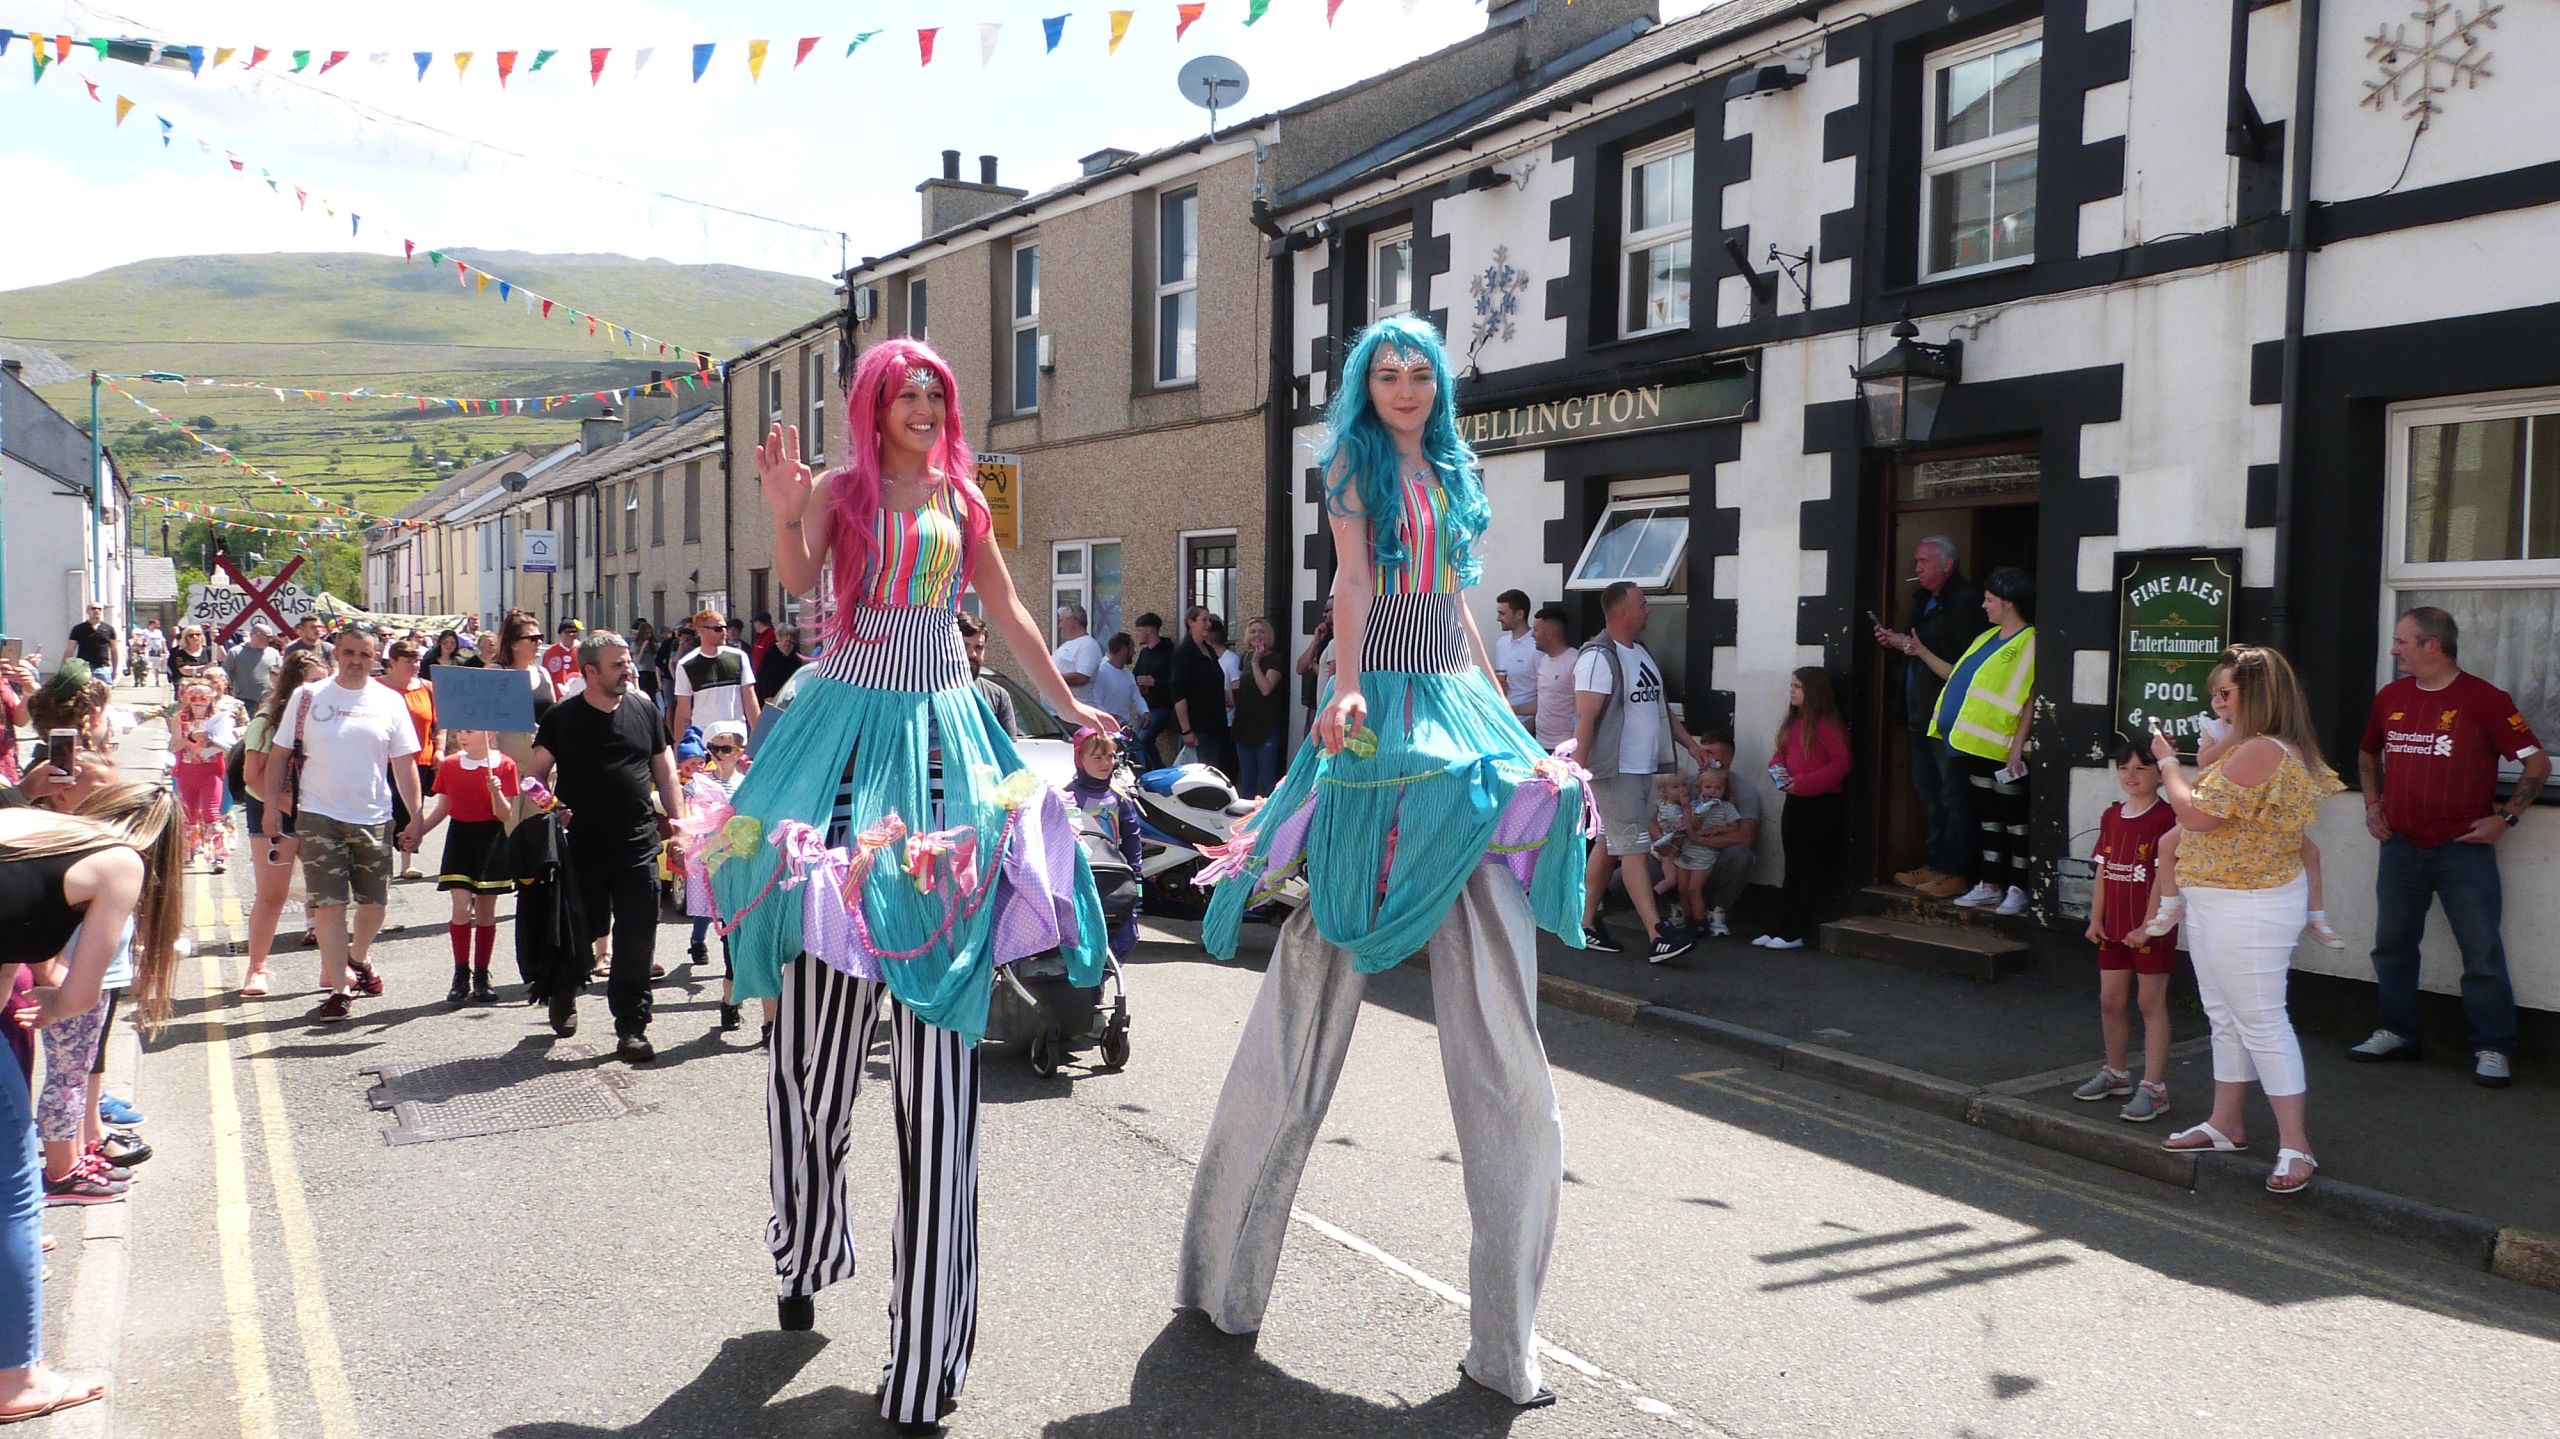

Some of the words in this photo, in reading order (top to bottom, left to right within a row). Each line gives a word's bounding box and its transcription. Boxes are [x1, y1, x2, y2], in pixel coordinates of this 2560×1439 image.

[978, 454, 999, 463] FLAT
[203, 586, 231, 602] NO
[275, 582, 297, 598] NO
[2129, 576, 2172, 607] FINE
[2177, 575, 2223, 606] ALES
[194, 592, 248, 620] BREXIT
[270, 598, 319, 615] PLAST
[2130, 630, 2220, 654] Entertainment
[2144, 682, 2199, 702] POOL
[2128, 707, 2143, 727] &
[2148, 710, 2208, 743] ART
[2386, 731, 2434, 743] Standard
[2384, 743, 2433, 755] Chartered
